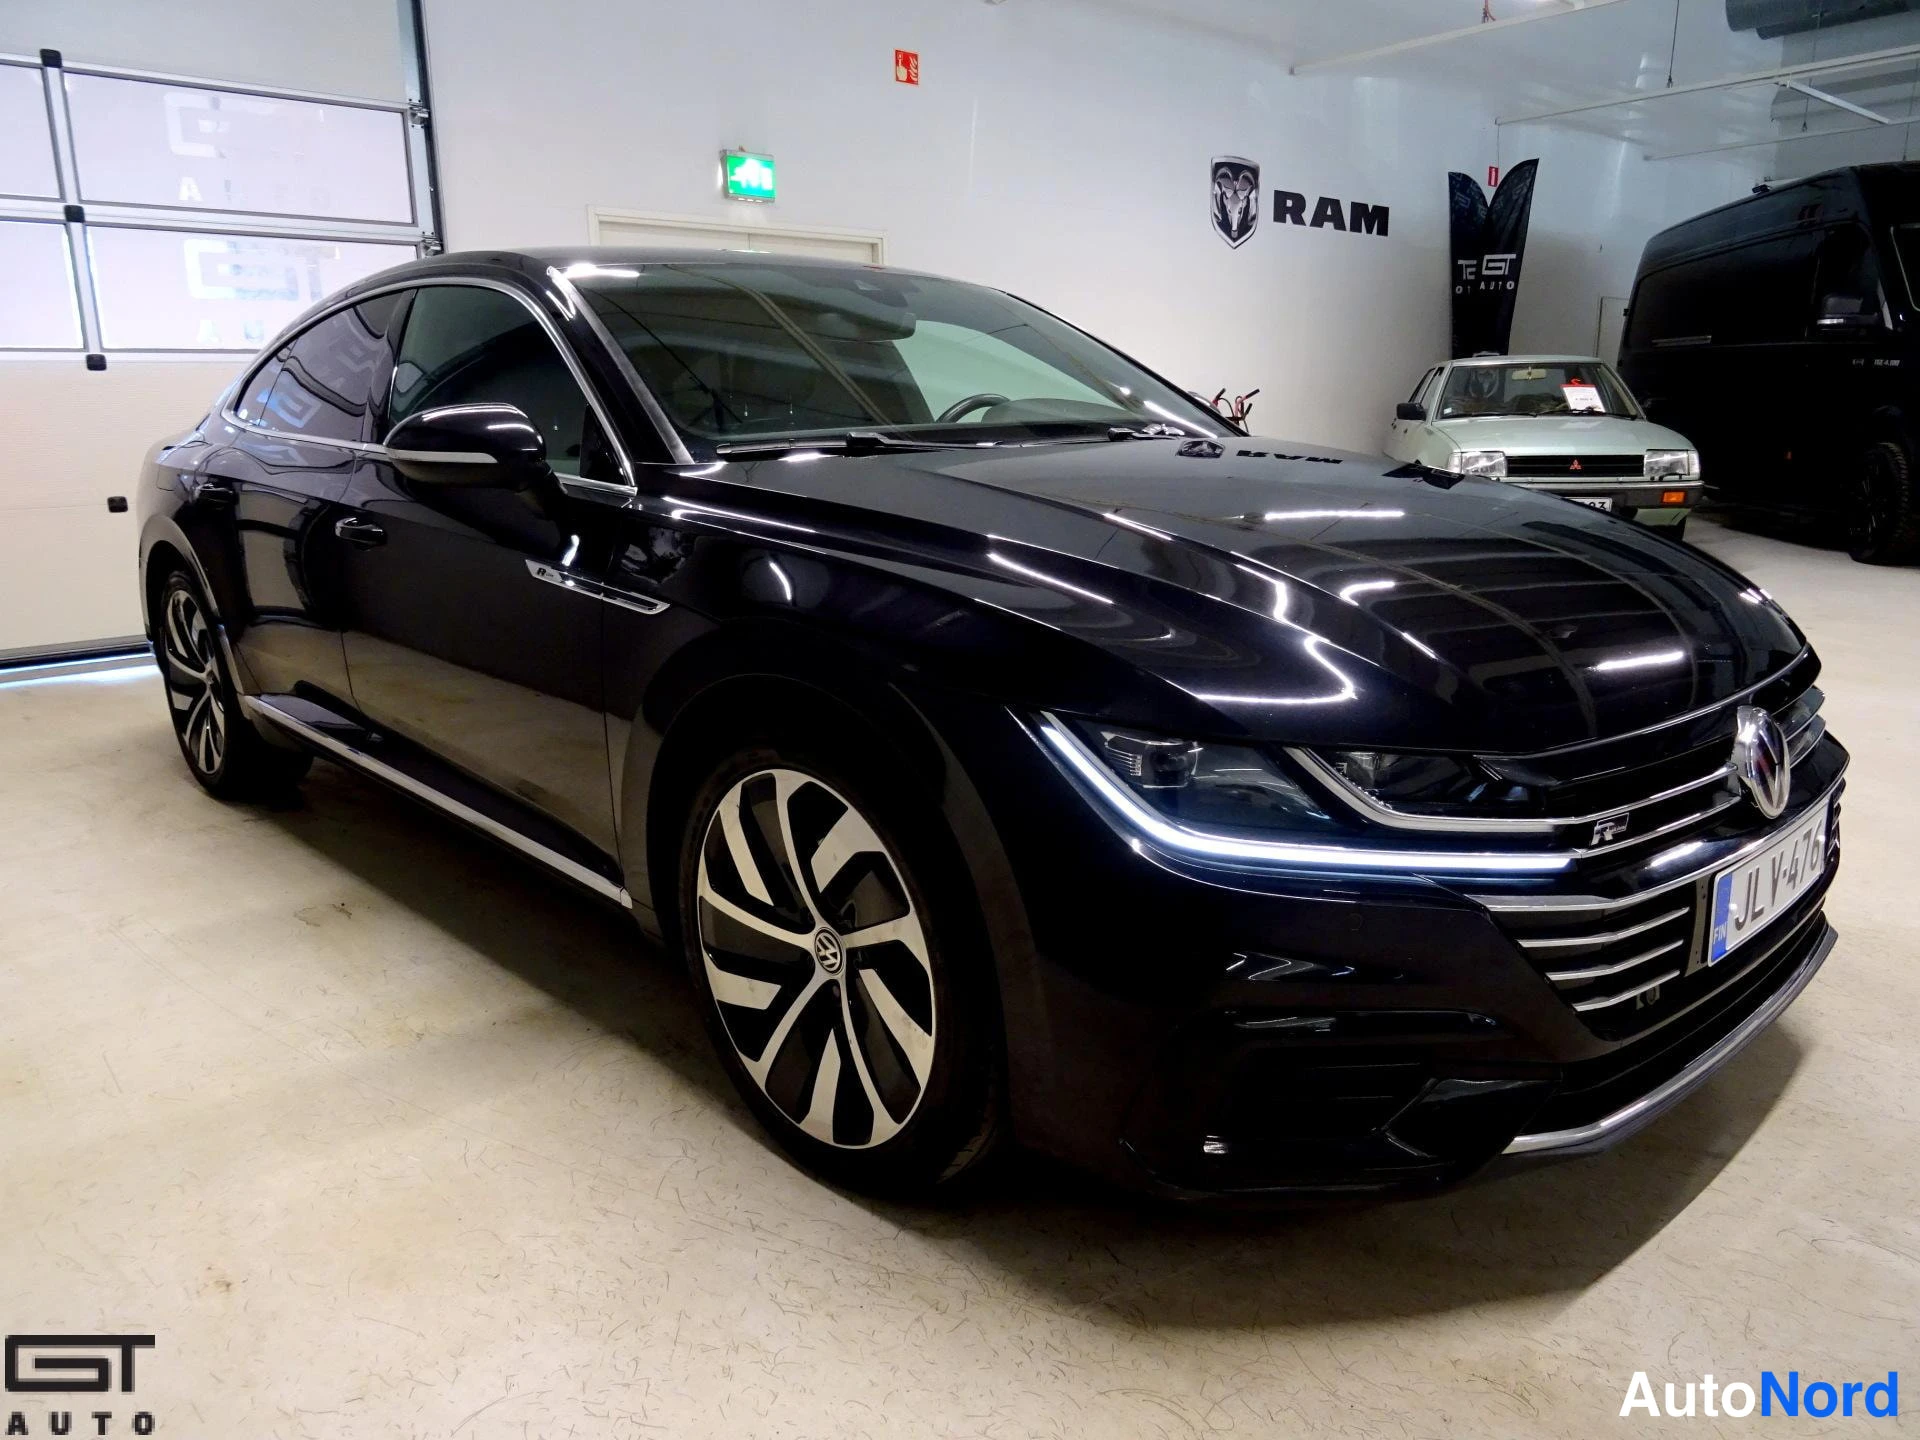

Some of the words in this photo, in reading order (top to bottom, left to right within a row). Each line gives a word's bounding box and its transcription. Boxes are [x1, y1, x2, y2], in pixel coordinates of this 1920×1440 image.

[1273, 190, 1390, 237] RAM
[1480, 281, 1515, 290] AUTO
[1734, 819, 1826, 932] JLV-476
[1713, 923, 1728, 946] FIN
